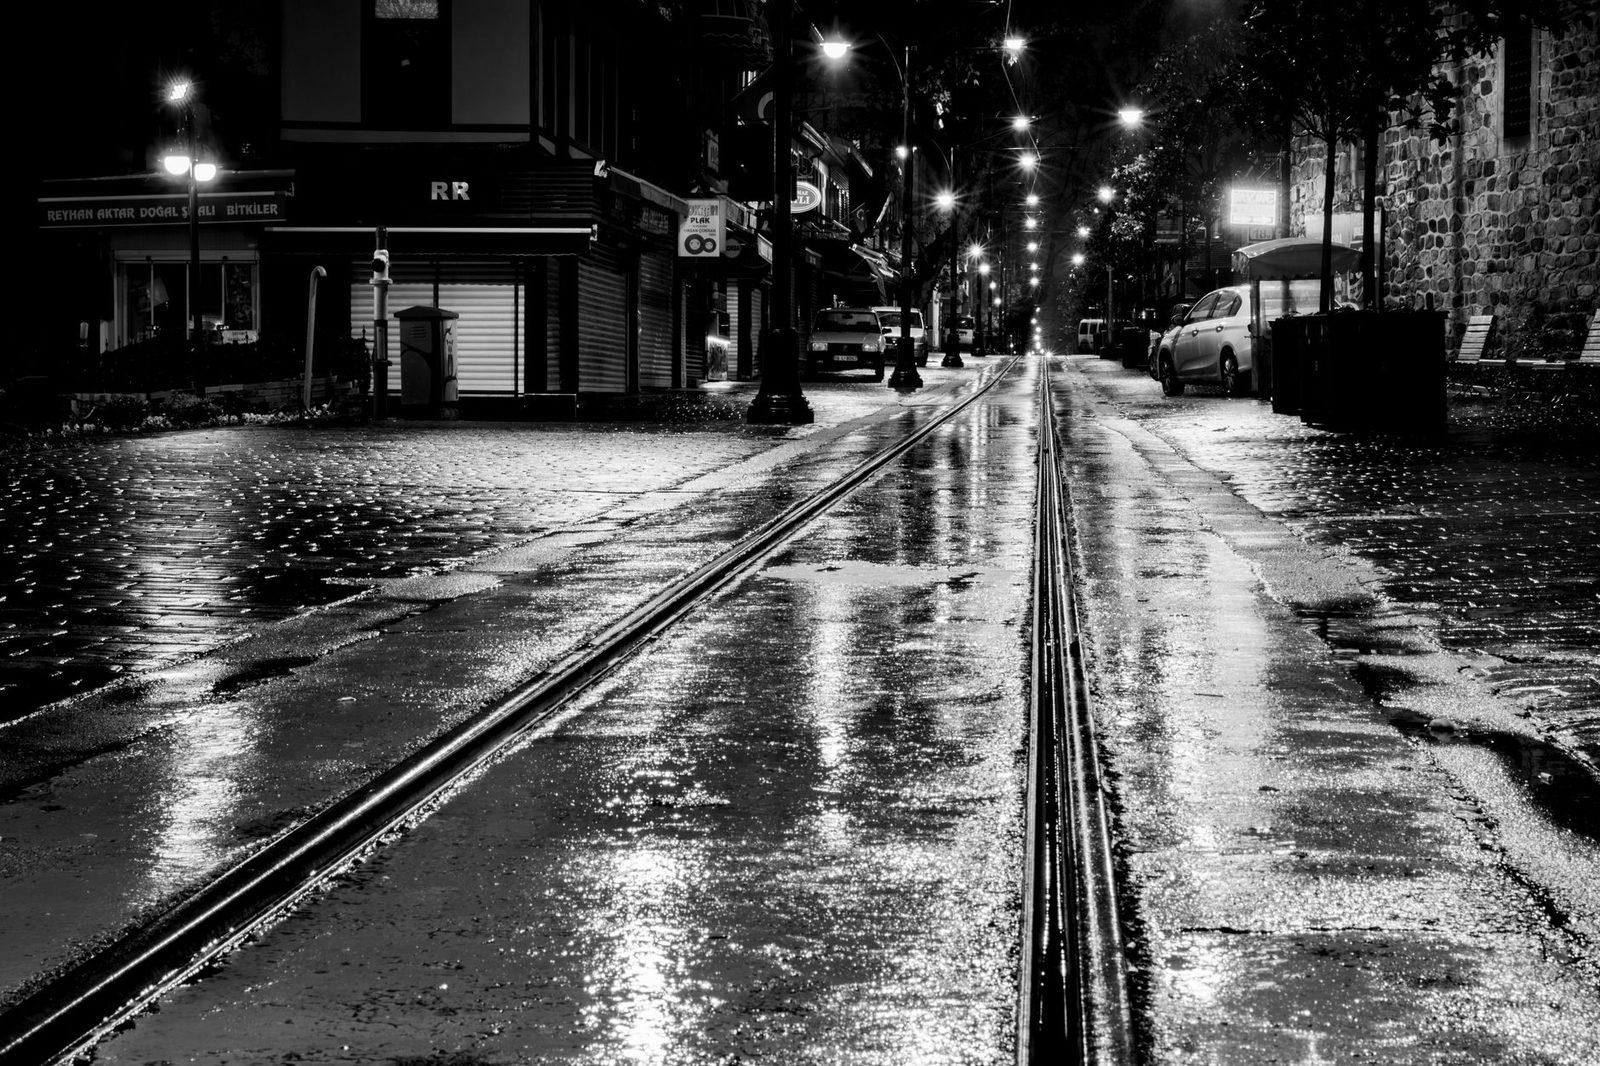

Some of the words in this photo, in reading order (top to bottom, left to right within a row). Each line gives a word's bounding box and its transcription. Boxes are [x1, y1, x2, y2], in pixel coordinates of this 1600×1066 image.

[431, 181, 471, 201] RR
[47, 208, 94, 222] REYHAN
[96, 207, 135, 220] AKTAR
[139, 205, 178, 218] DOĞAL
[226, 201, 278, 216] BİTKİLER
